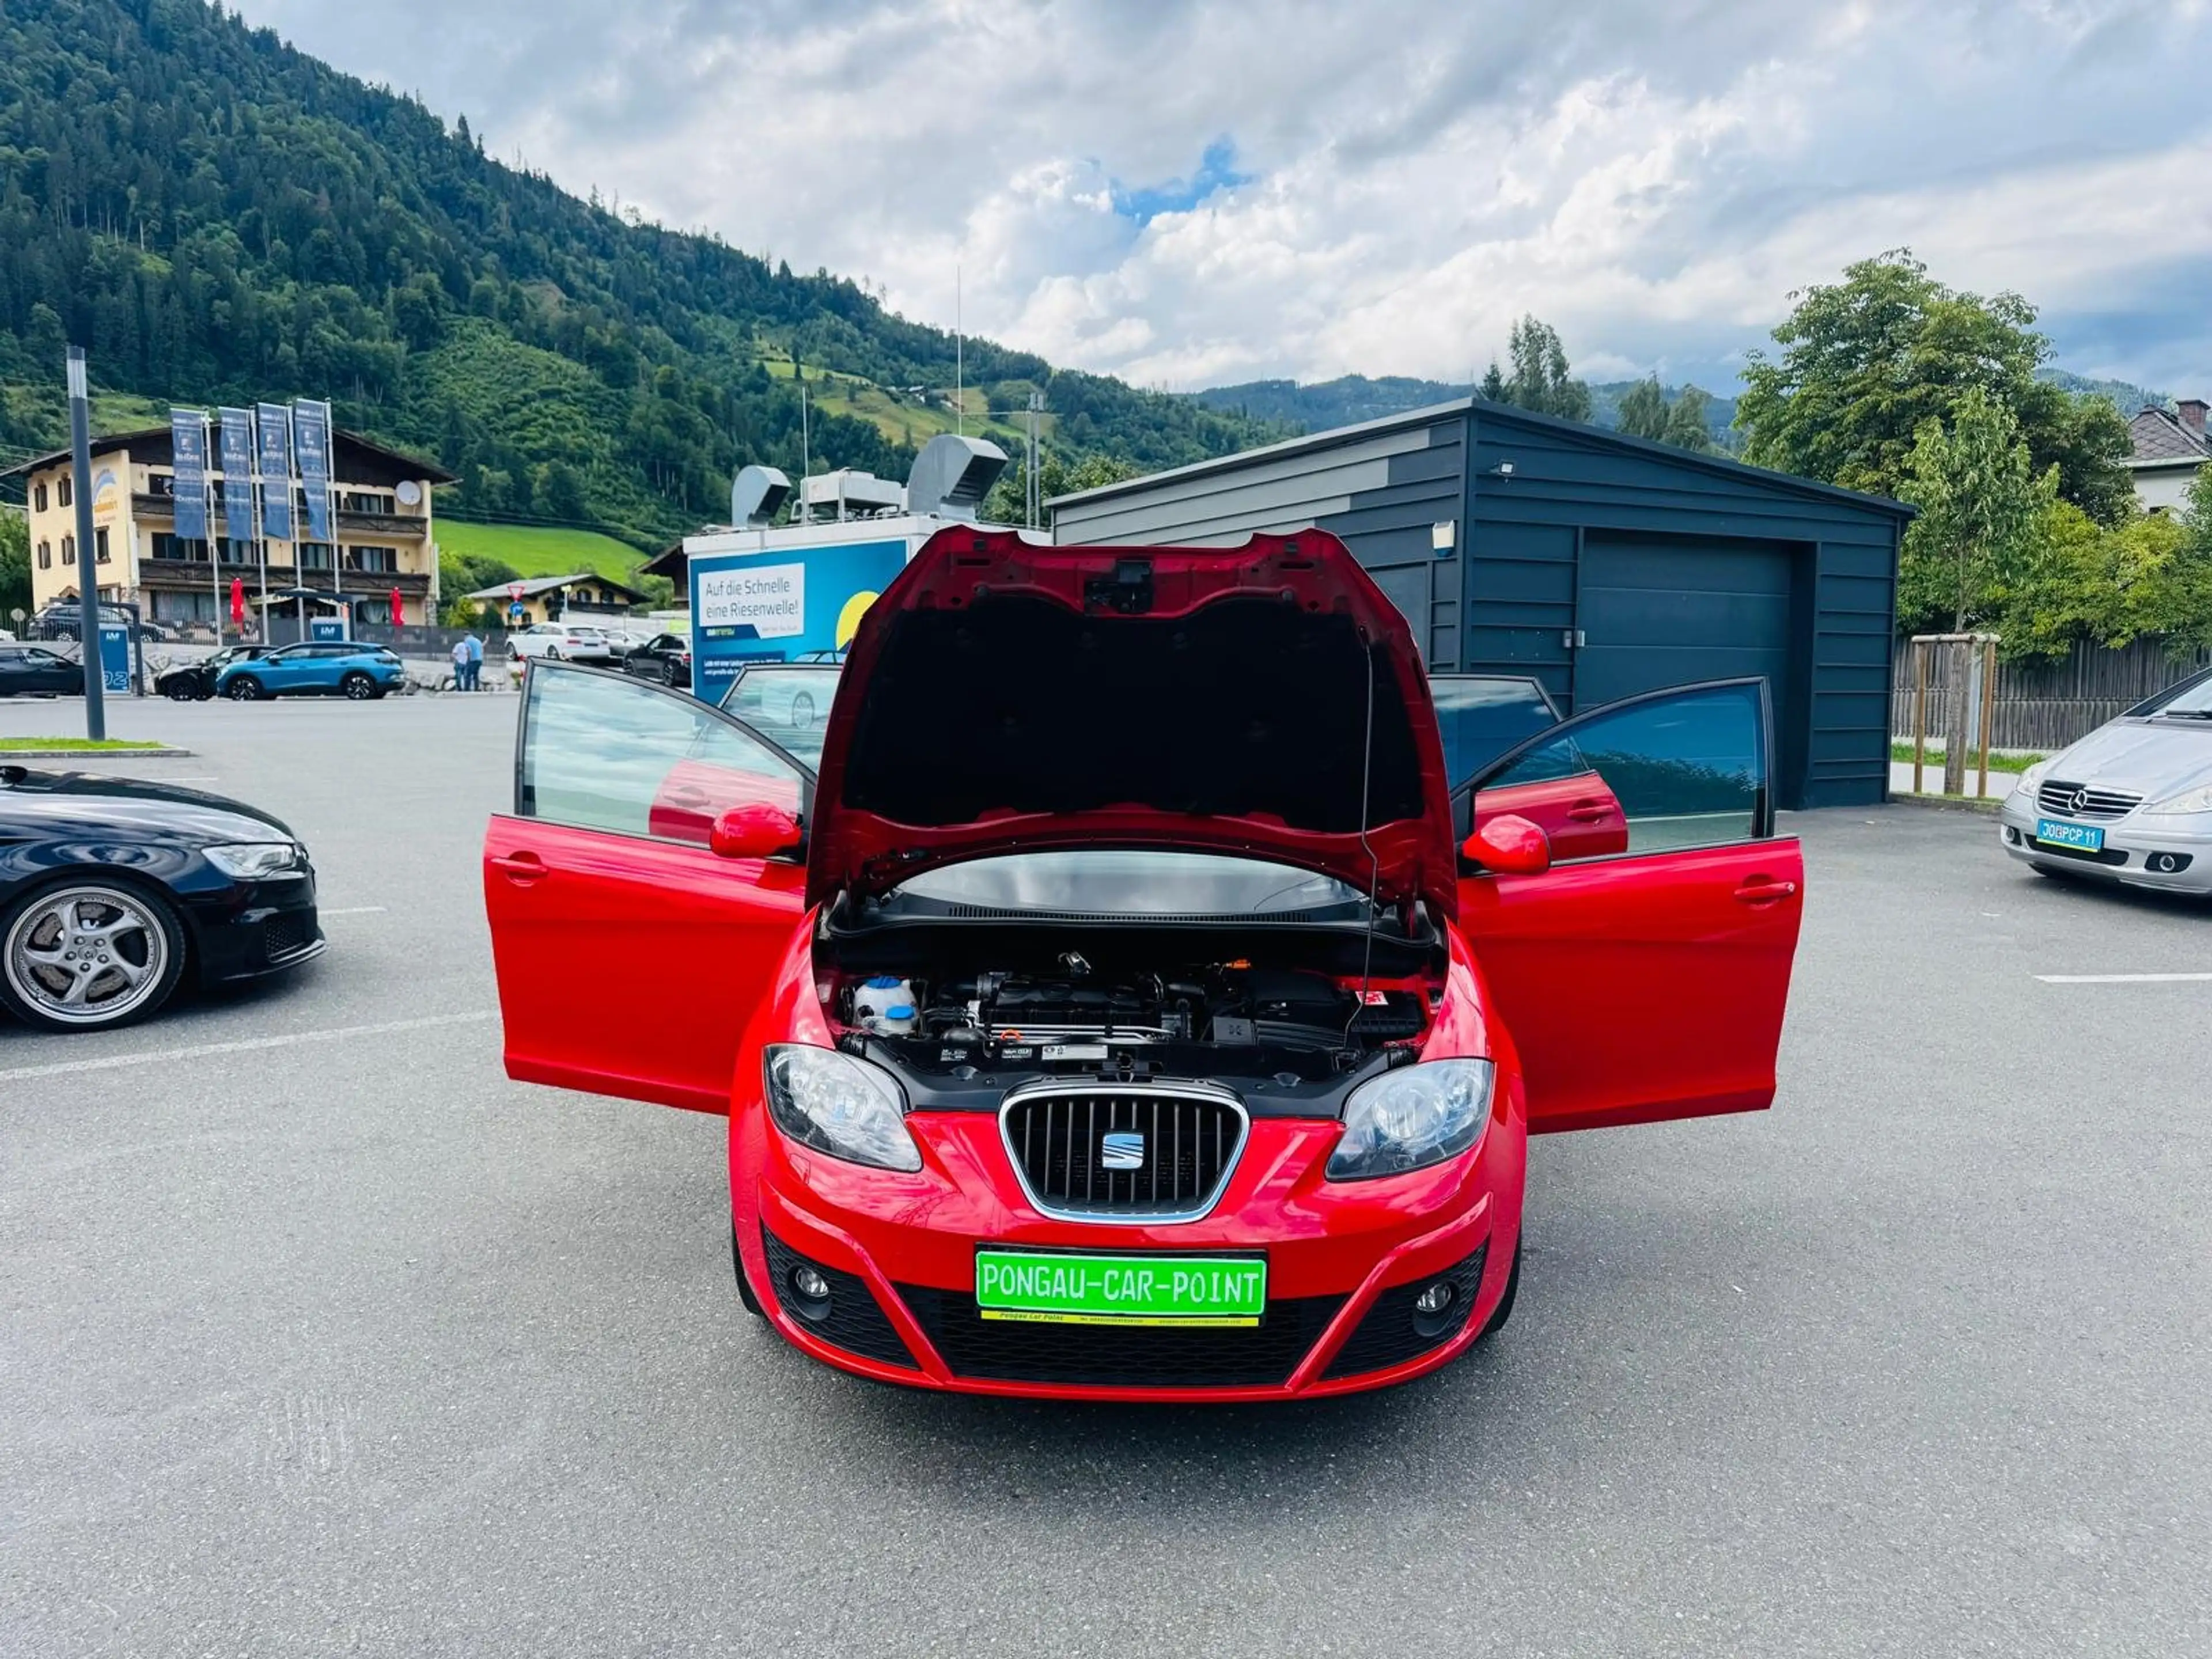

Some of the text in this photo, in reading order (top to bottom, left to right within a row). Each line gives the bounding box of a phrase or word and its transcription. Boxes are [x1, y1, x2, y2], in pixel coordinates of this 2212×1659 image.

[706, 577, 790, 596] Auf die Schnelle
[706, 599, 799, 619] eine Riesenwelle!
[982, 1263, 1260, 1304] PONGAU-CAR-POINT
